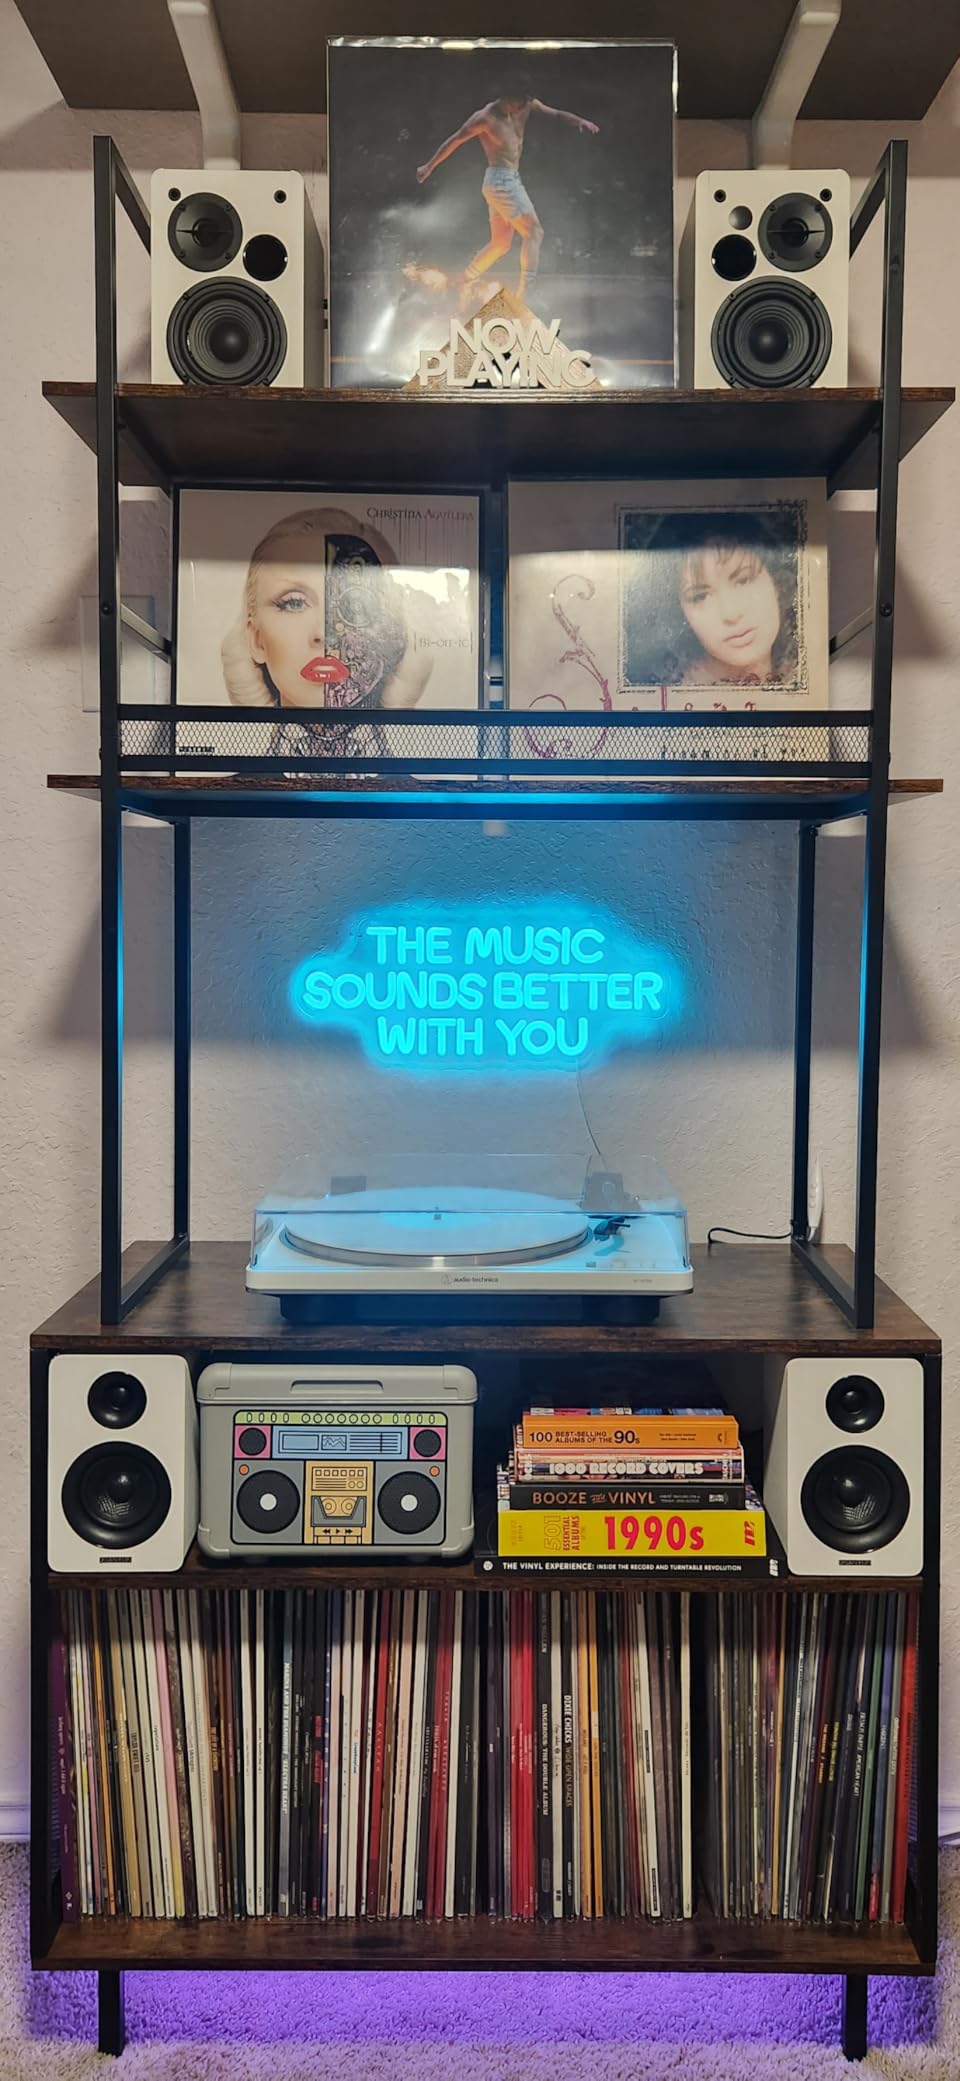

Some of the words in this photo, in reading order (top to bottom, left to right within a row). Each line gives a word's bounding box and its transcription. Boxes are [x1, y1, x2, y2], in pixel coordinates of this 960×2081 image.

[449, 318, 561, 355] NOW
[416, 350, 597, 388] PLAYING
[366, 926, 452, 964] THE
[465, 926, 605, 965] MUSIC
[302, 971, 487, 1010] SOUNDS
[492, 972, 664, 1010] BETTER
[377, 1017, 484, 1056] WITH
[495, 1018, 589, 1056] YOU
[529, 1432, 553, 1443] 100
[555, 1431, 607, 1439] BEST-SELLING
[614, 1430, 641, 1445] 90s
[549, 1463, 586, 1475] 1000
[589, 1463, 646, 1475] RECORD
[648, 1463, 704, 1475] COVERS
[532, 1492, 587, 1504] BOOZE
[607, 1492, 656, 1504] VINYL
[544, 1516, 560, 1551] 501
[562, 1515, 570, 1551] ESSENTIAL
[571, 1515, 580, 1551] ALBUMS
[604, 1516, 704, 1550] 1990s
[502, 1562, 518, 1570] THE
[520, 1562, 543, 1570] VINYL
[545, 1562, 595, 1570] EXPERIENCE:
[564, 1695, 572, 1715] DIXIE
[564, 1717, 572, 1743] CHICKS
